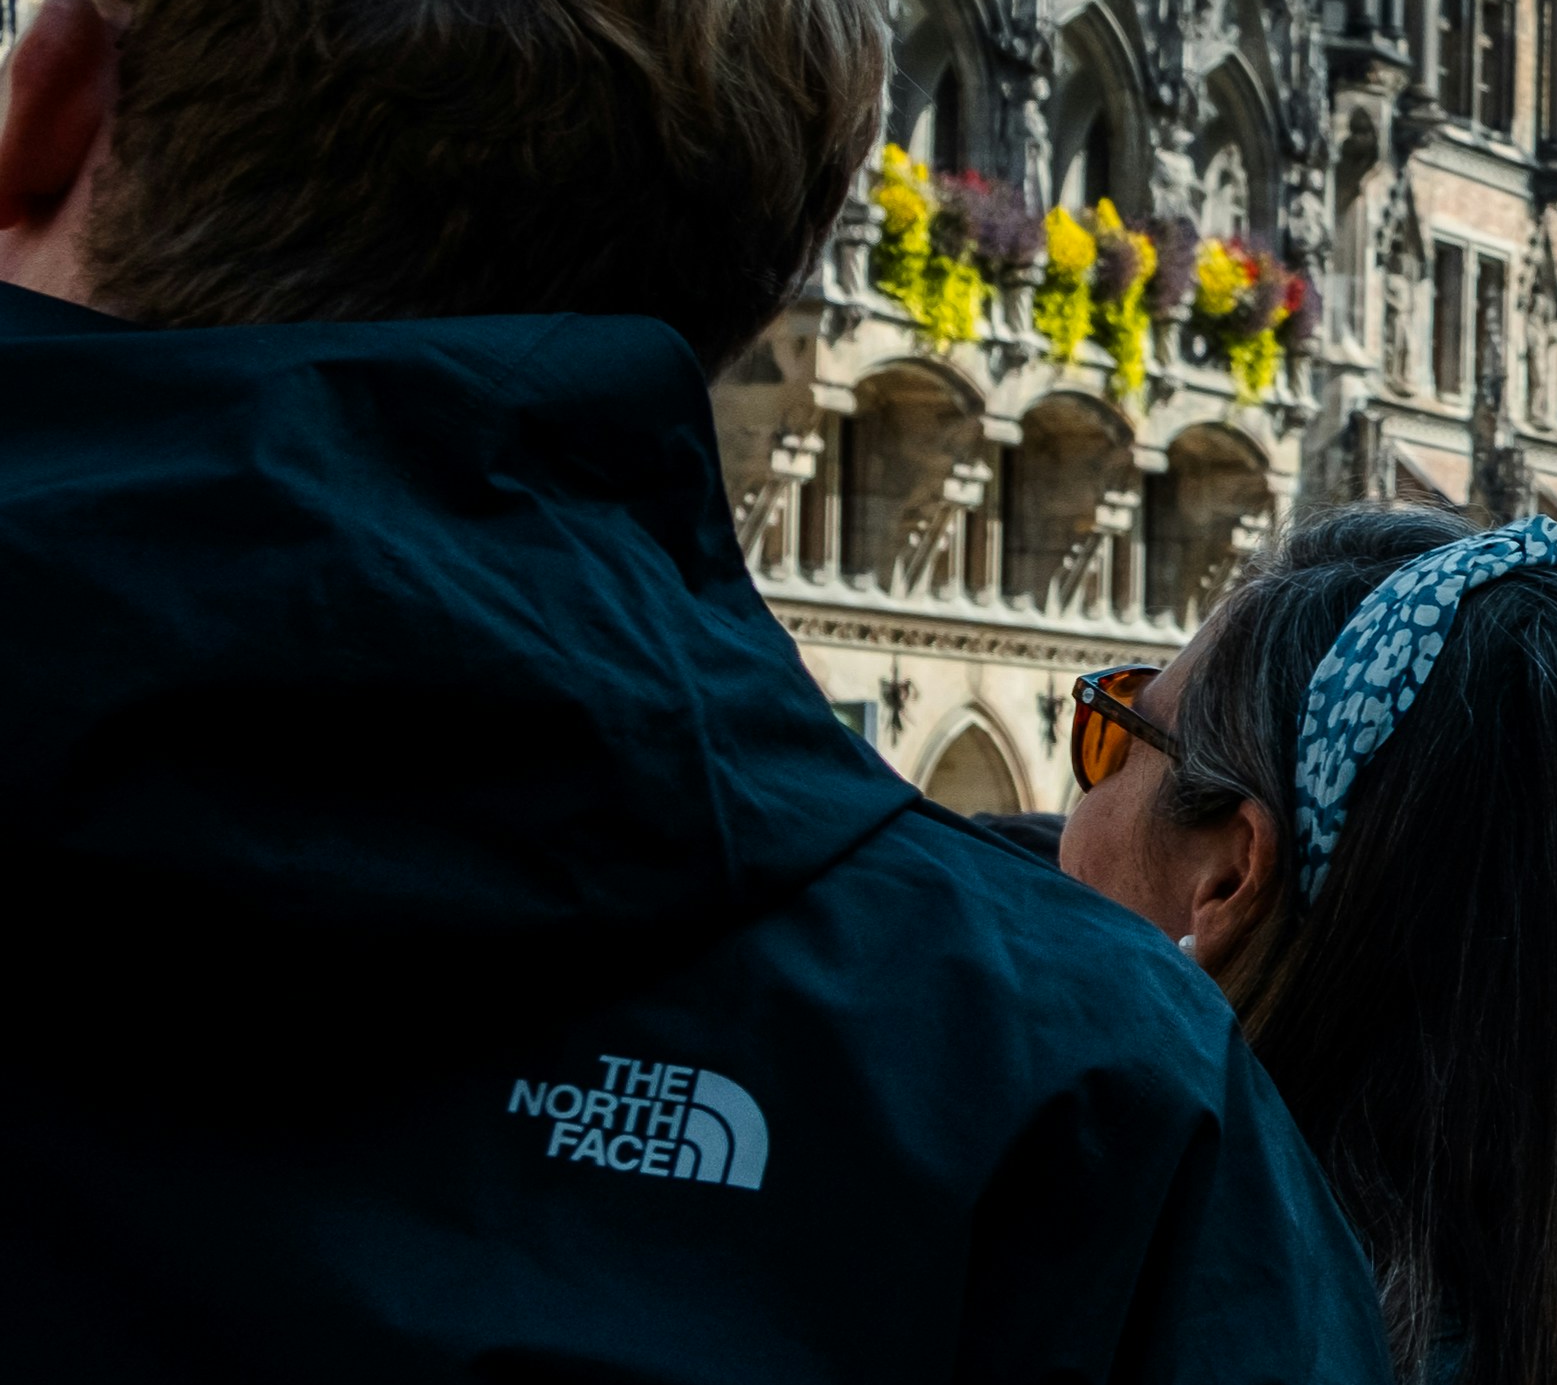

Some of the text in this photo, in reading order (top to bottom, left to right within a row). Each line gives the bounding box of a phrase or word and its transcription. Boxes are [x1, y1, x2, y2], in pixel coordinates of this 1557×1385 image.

[600, 1054, 694, 1104] THE
[507, 1079, 685, 1140] NORTH
[547, 1121, 675, 1177] FACE
